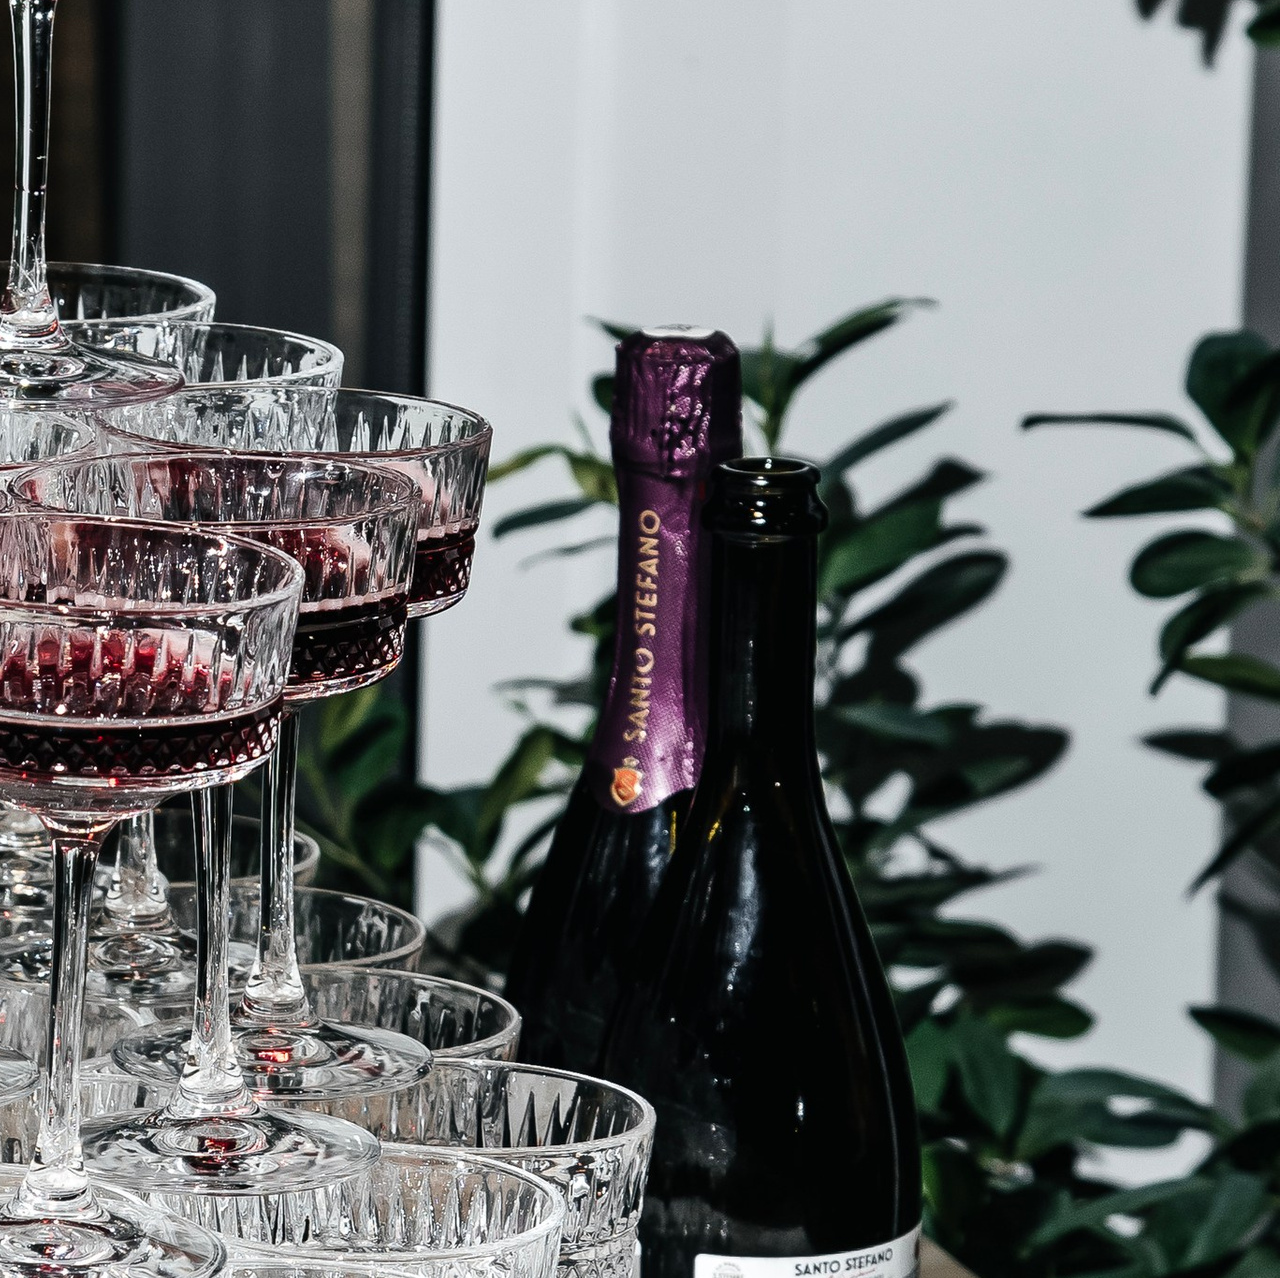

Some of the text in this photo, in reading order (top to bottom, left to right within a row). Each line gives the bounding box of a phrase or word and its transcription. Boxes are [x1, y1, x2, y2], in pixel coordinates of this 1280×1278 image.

[623, 509, 662, 743] SANTO STEFANO
[795, 1247, 894, 1277] SANTO STEFANO
